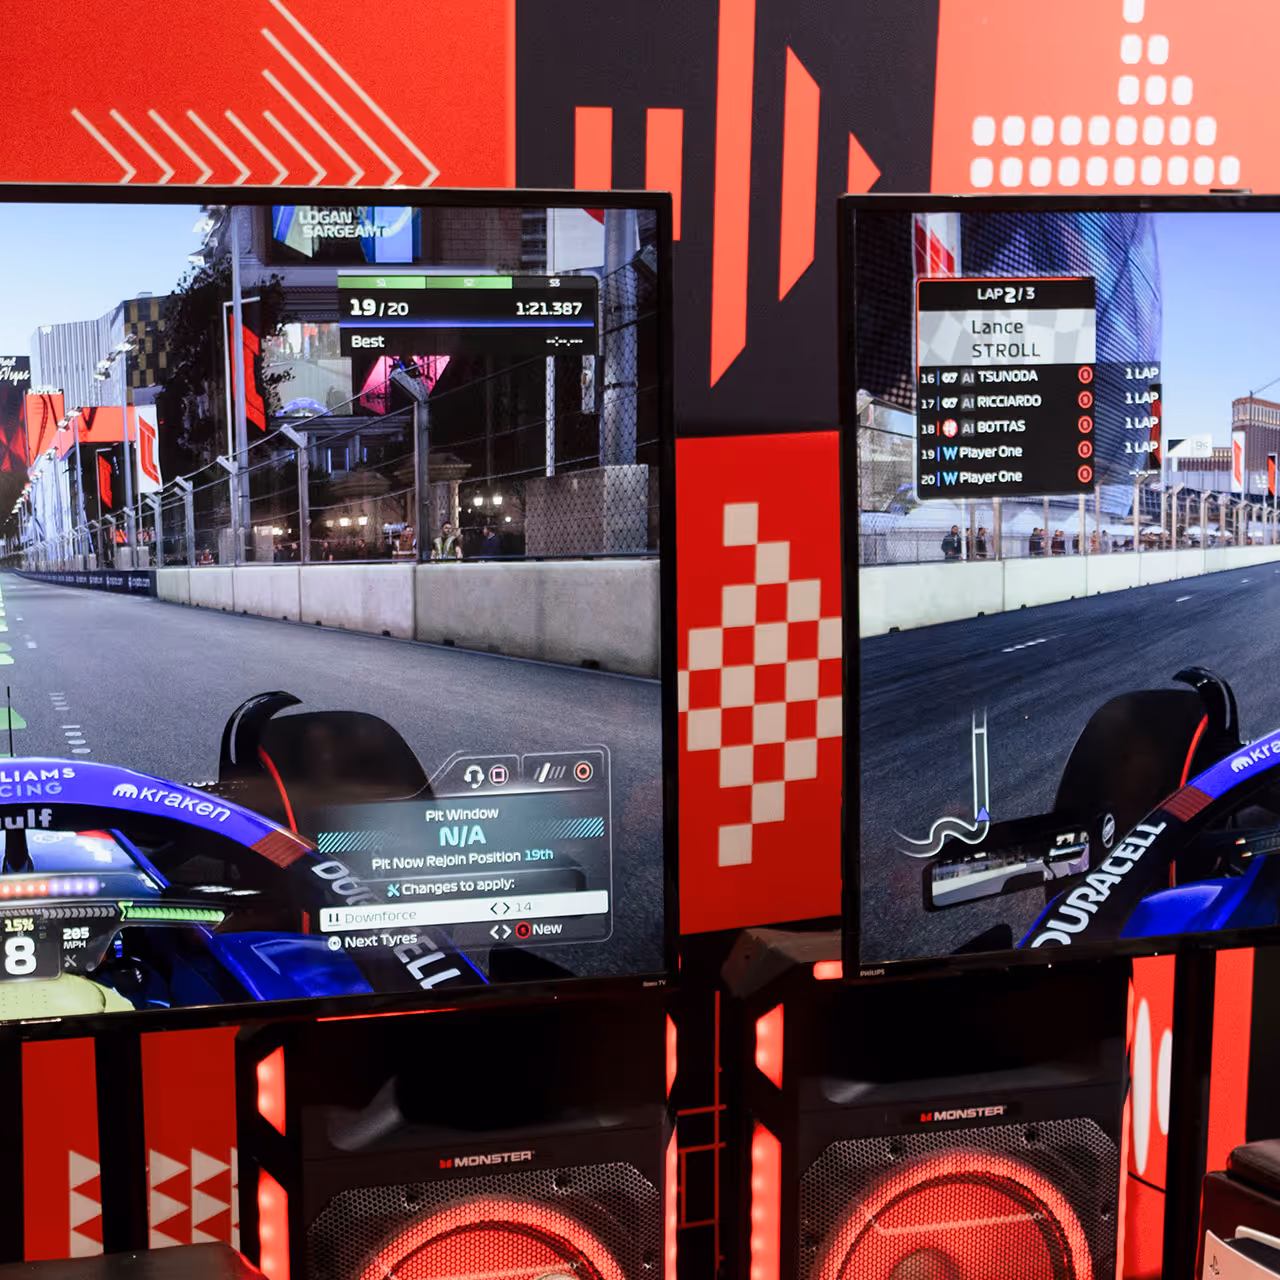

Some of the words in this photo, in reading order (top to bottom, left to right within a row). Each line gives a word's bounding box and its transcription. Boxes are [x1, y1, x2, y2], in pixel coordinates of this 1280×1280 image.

[299, 211, 352, 224] LOGAN
[977, 288, 1003, 300] LAP
[516, 302, 582, 316] 1:21.387
[972, 320, 1024, 334] Lance
[352, 334, 385, 348] Best
[972, 343, 1040, 358] STROLL
[921, 374, 935, 384] 16
[978, 371, 1038, 383] TSUNODA
[1135, 368, 1159, 379] LAP
[921, 399, 935, 409] 17
[977, 395, 1042, 408] RICCIARDO
[1135, 392, 1159, 404] LAP
[921, 425, 935, 435] 18
[977, 420, 1026, 433] BOTTAS
[1135, 417, 1159, 428] LAP
[921, 450, 935, 460] 19
[959, 447, 997, 460] Player
[999, 446, 1023, 457] One
[1135, 441, 1159, 453] LAP
[921, 475, 936, 485] 20
[959, 472, 997, 485] Player
[999, 471, 1023, 482] One
[138, 786, 231, 822] kraken
[425, 810, 444, 822] Pit
[446, 807, 499, 821] Window
[439, 825, 486, 847] N/A
[372, 858, 391, 871] Pit
[393, 856, 424, 870] Now
[426, 853, 468, 868] Rejoin
[469, 850, 521, 865] Position
[524, 849, 554, 861] 19th
[402, 881, 457, 896] Changes
[459, 880, 474, 893] to
[476, 877, 515, 893] apply:
[345, 909, 417, 924] Downforce
[515, 901, 532, 912] 14
[4, 918, 34, 932] 15%
[344, 934, 378, 949] Next
[380, 932, 418, 947] Tyres
[532, 922, 563, 936] New
[63, 940, 86, 949] MPH
[4, 935, 37, 975] 8
[933, 1104, 1005, 1122] MONSTER
[454, 1151, 533, 1168] MONSTER
